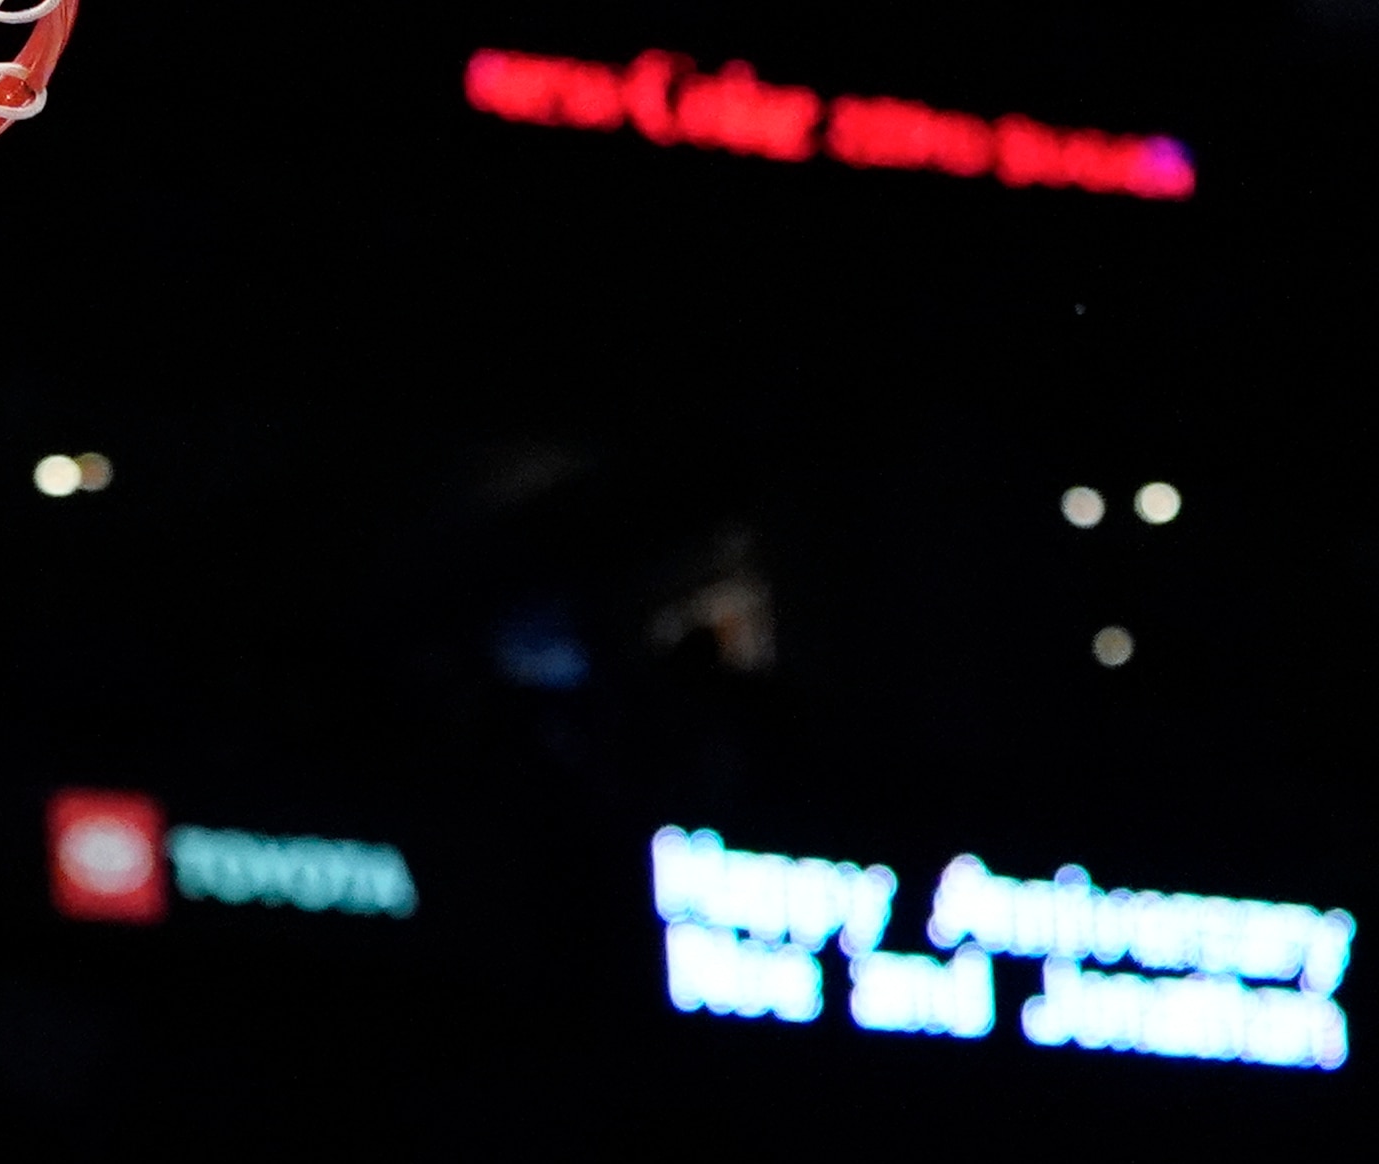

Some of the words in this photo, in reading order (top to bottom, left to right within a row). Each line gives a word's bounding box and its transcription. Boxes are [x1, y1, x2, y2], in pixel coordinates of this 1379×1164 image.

[165, 823, 419, 920] TOYOTA
[651, 824, 898, 957] Happy
[926, 853, 1357, 998] Anniversary
[848, 942, 995, 1038] and
